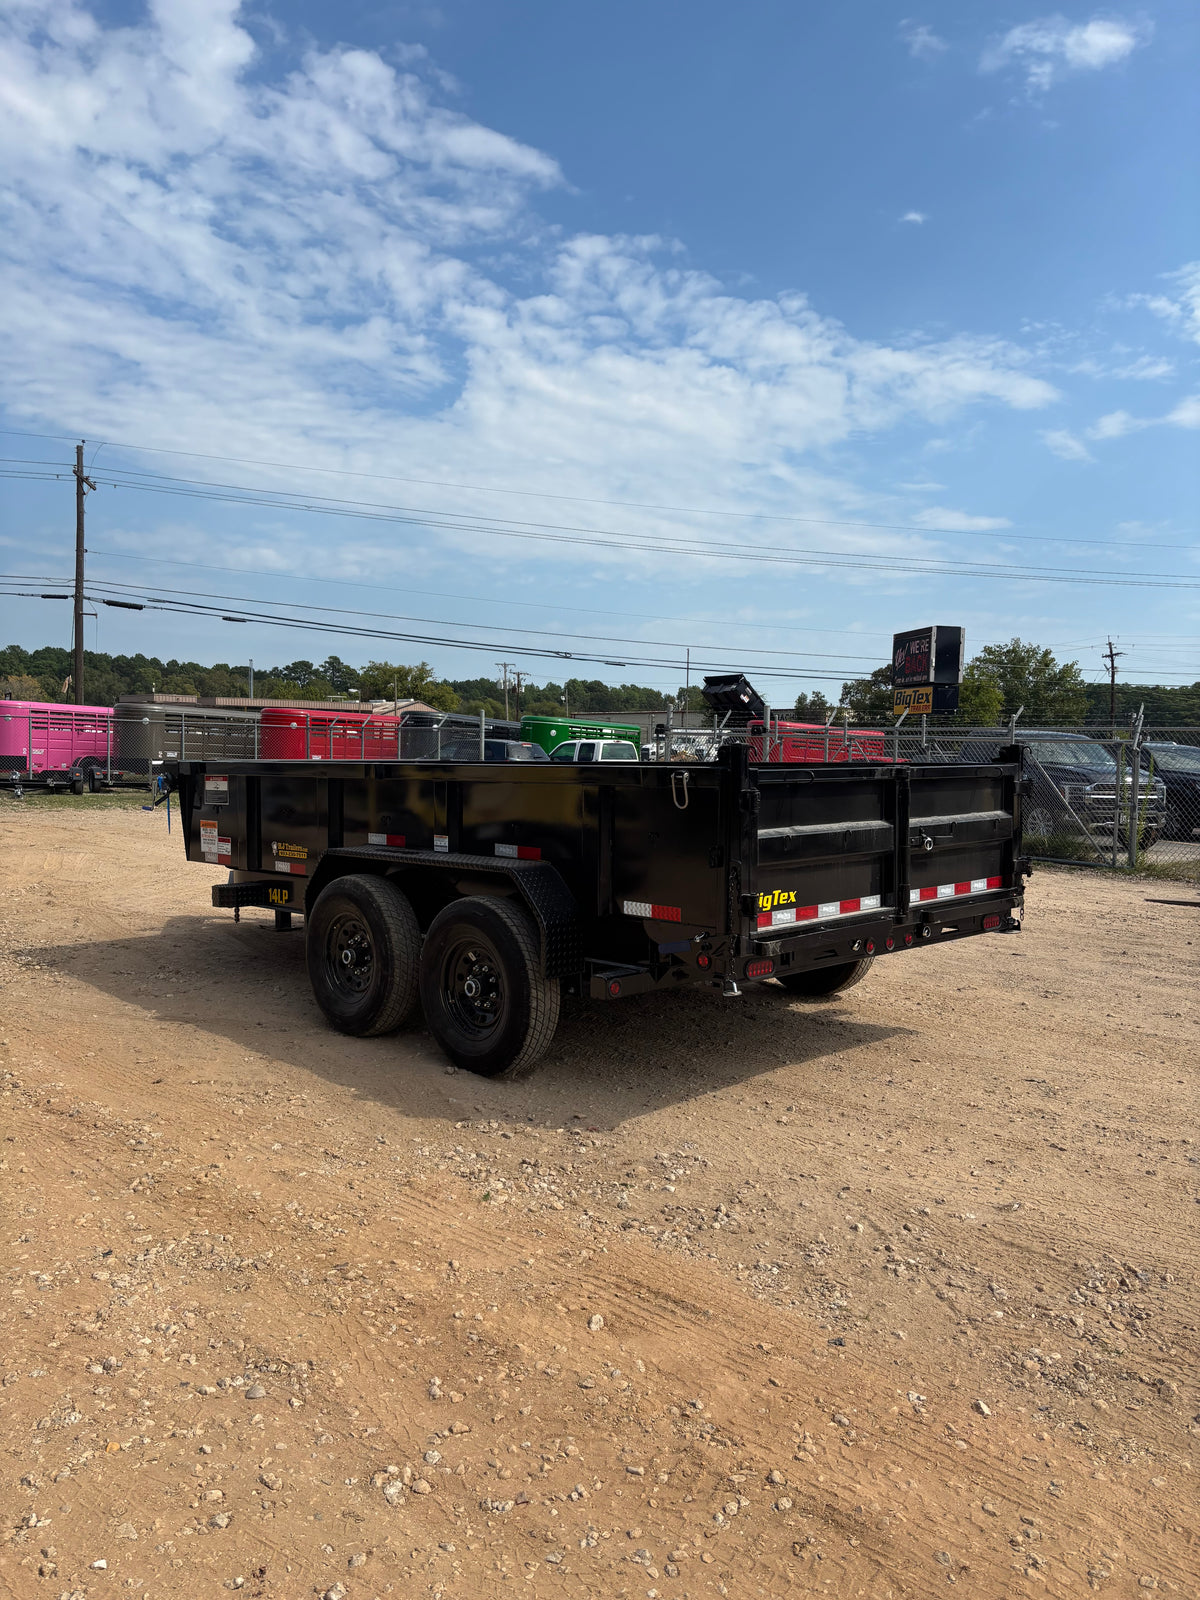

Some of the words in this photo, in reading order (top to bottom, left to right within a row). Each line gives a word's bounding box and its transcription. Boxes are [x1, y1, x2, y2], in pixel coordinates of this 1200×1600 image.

[894, 689, 932, 709] BigTex
[268, 887, 288, 904] 14LP
[757, 889, 797, 911] igTex
